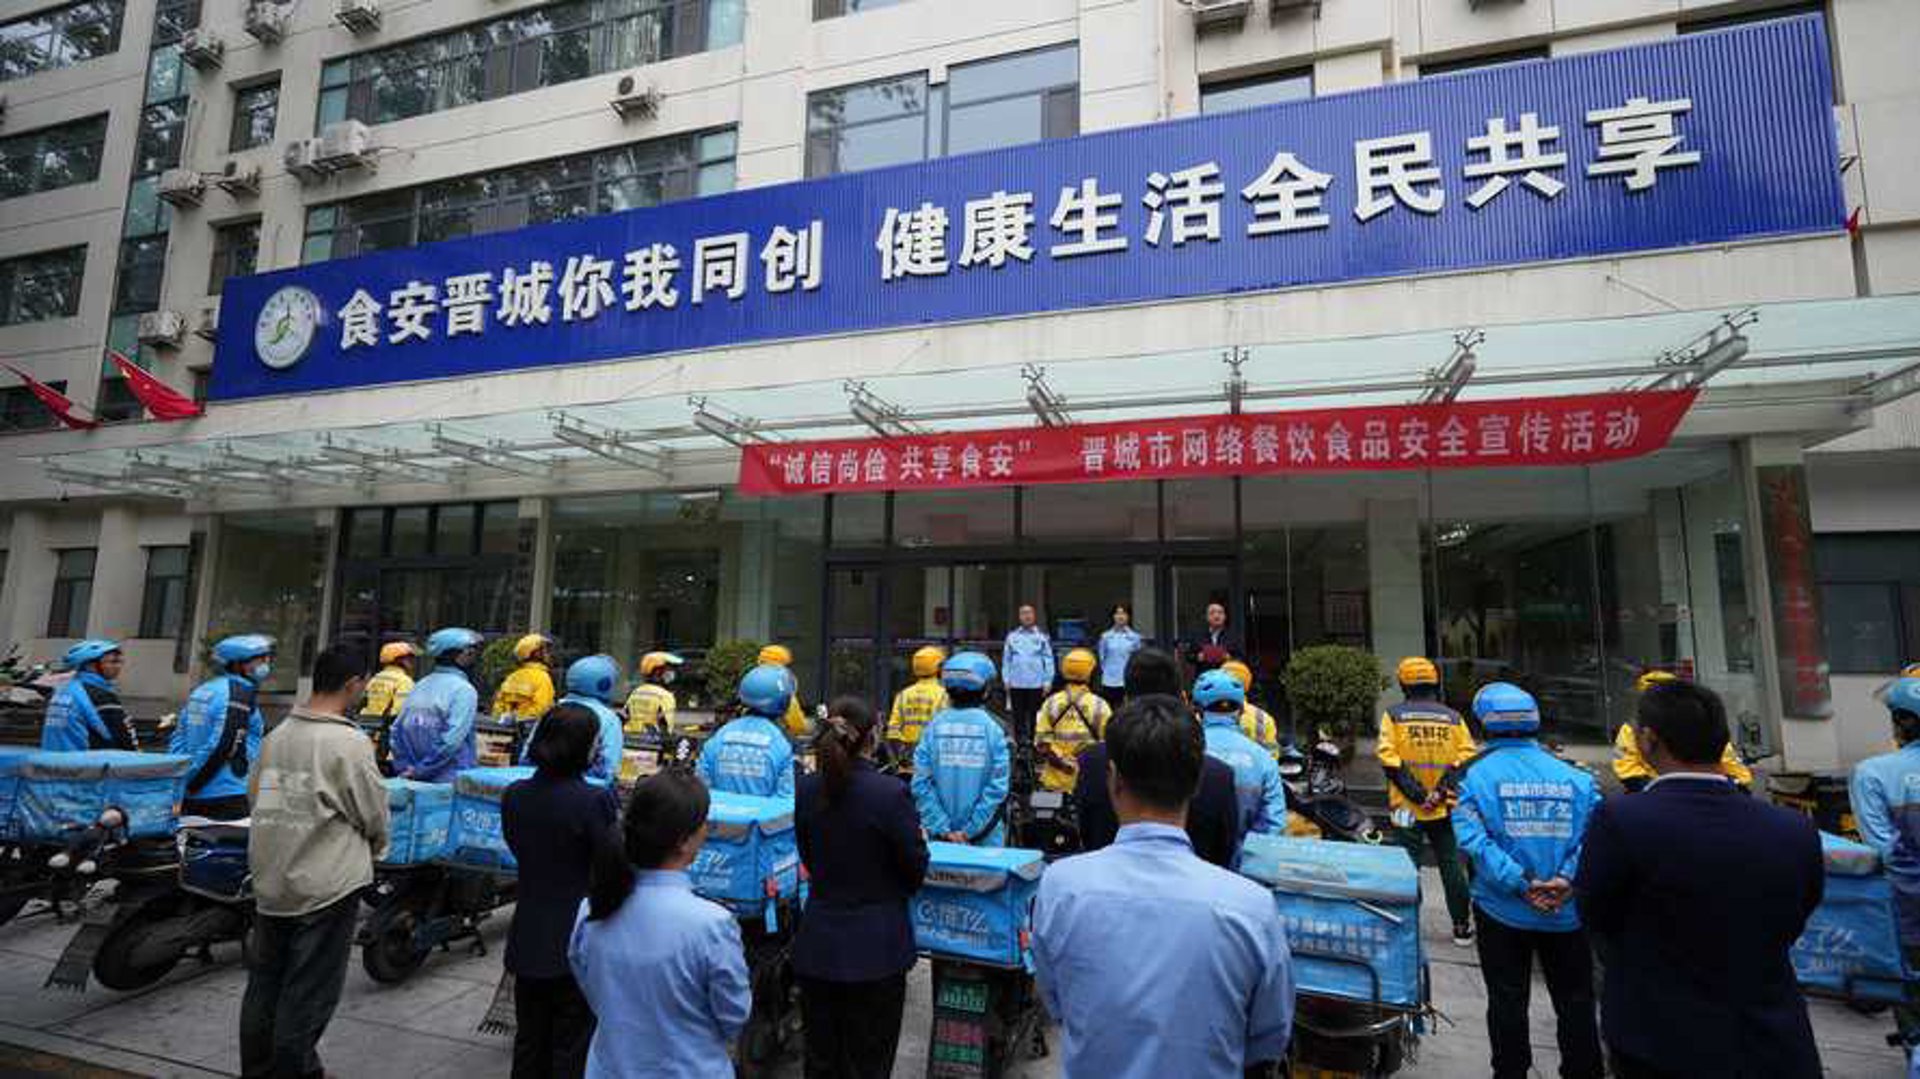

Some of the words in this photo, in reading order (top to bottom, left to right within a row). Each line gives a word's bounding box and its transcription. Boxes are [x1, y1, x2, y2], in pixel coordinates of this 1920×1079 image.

[337, 220, 823, 352] 食安晋城你我同创
[877, 97, 1702, 281] 健康生活全民共享
[1080, 406, 1640, 474] 晋城市网络餐饮食品安全宣传活动
